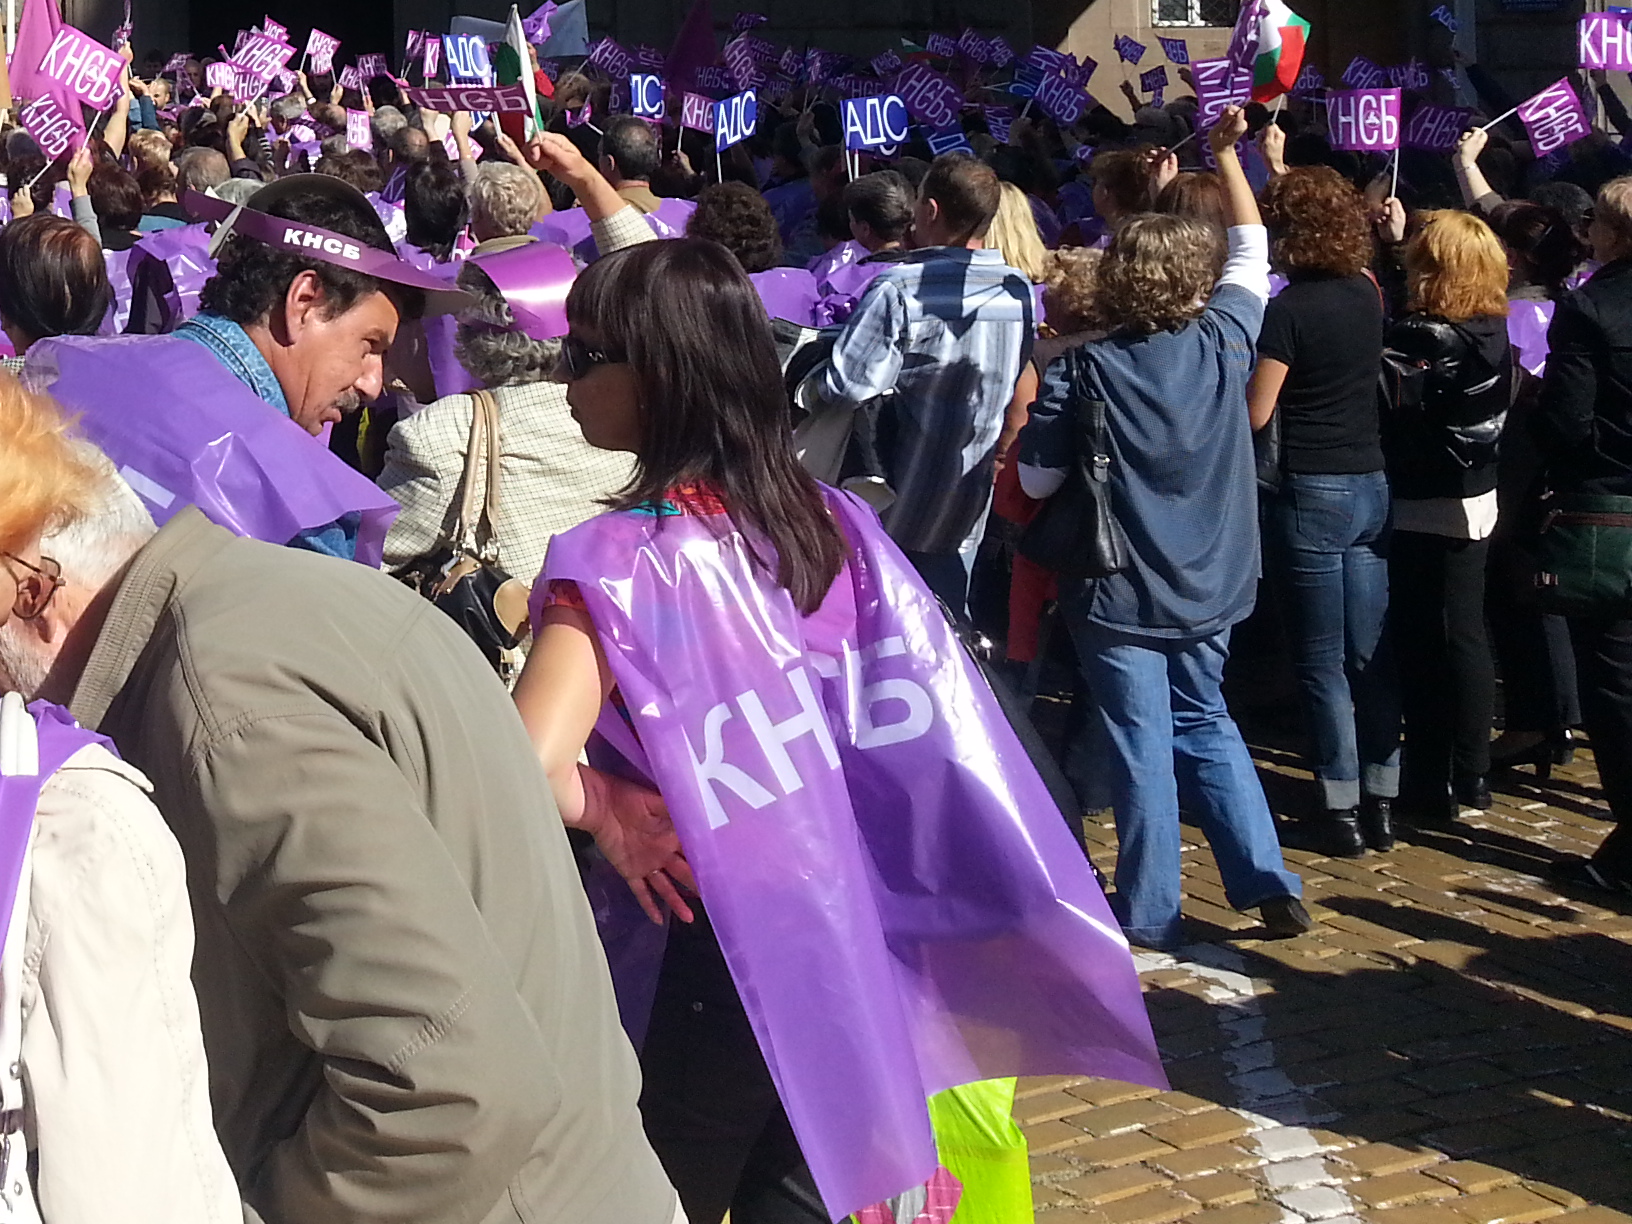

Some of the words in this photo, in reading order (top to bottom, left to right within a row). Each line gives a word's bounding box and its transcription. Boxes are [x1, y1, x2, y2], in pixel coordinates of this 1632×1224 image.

[230, 36, 293, 80] КНСБ
[308, 32, 338, 56] КНСБ
[445, 36, 490, 77] АДС
[590, 38, 635, 80] КНСБ
[926, 34, 957, 57] КНСБ
[958, 28, 989, 64] КНСБ
[1579, 18, 1632, 65] КН
[39, 29, 121, 103] КНСБ
[233, 73, 266, 100] КНС
[339, 66, 362, 89] КНС
[682, 95, 713, 130] КНС
[1035, 71, 1085, 122] КНСБ
[1520, 83, 1583, 152] КНСБ
[22, 92, 80, 157] КНСБ
[718, 91, 756, 146] АДС
[845, 96, 909, 146] АДС
[282, 227, 361, 261] КНСБ
[681, 635, 933, 830] КНБ
